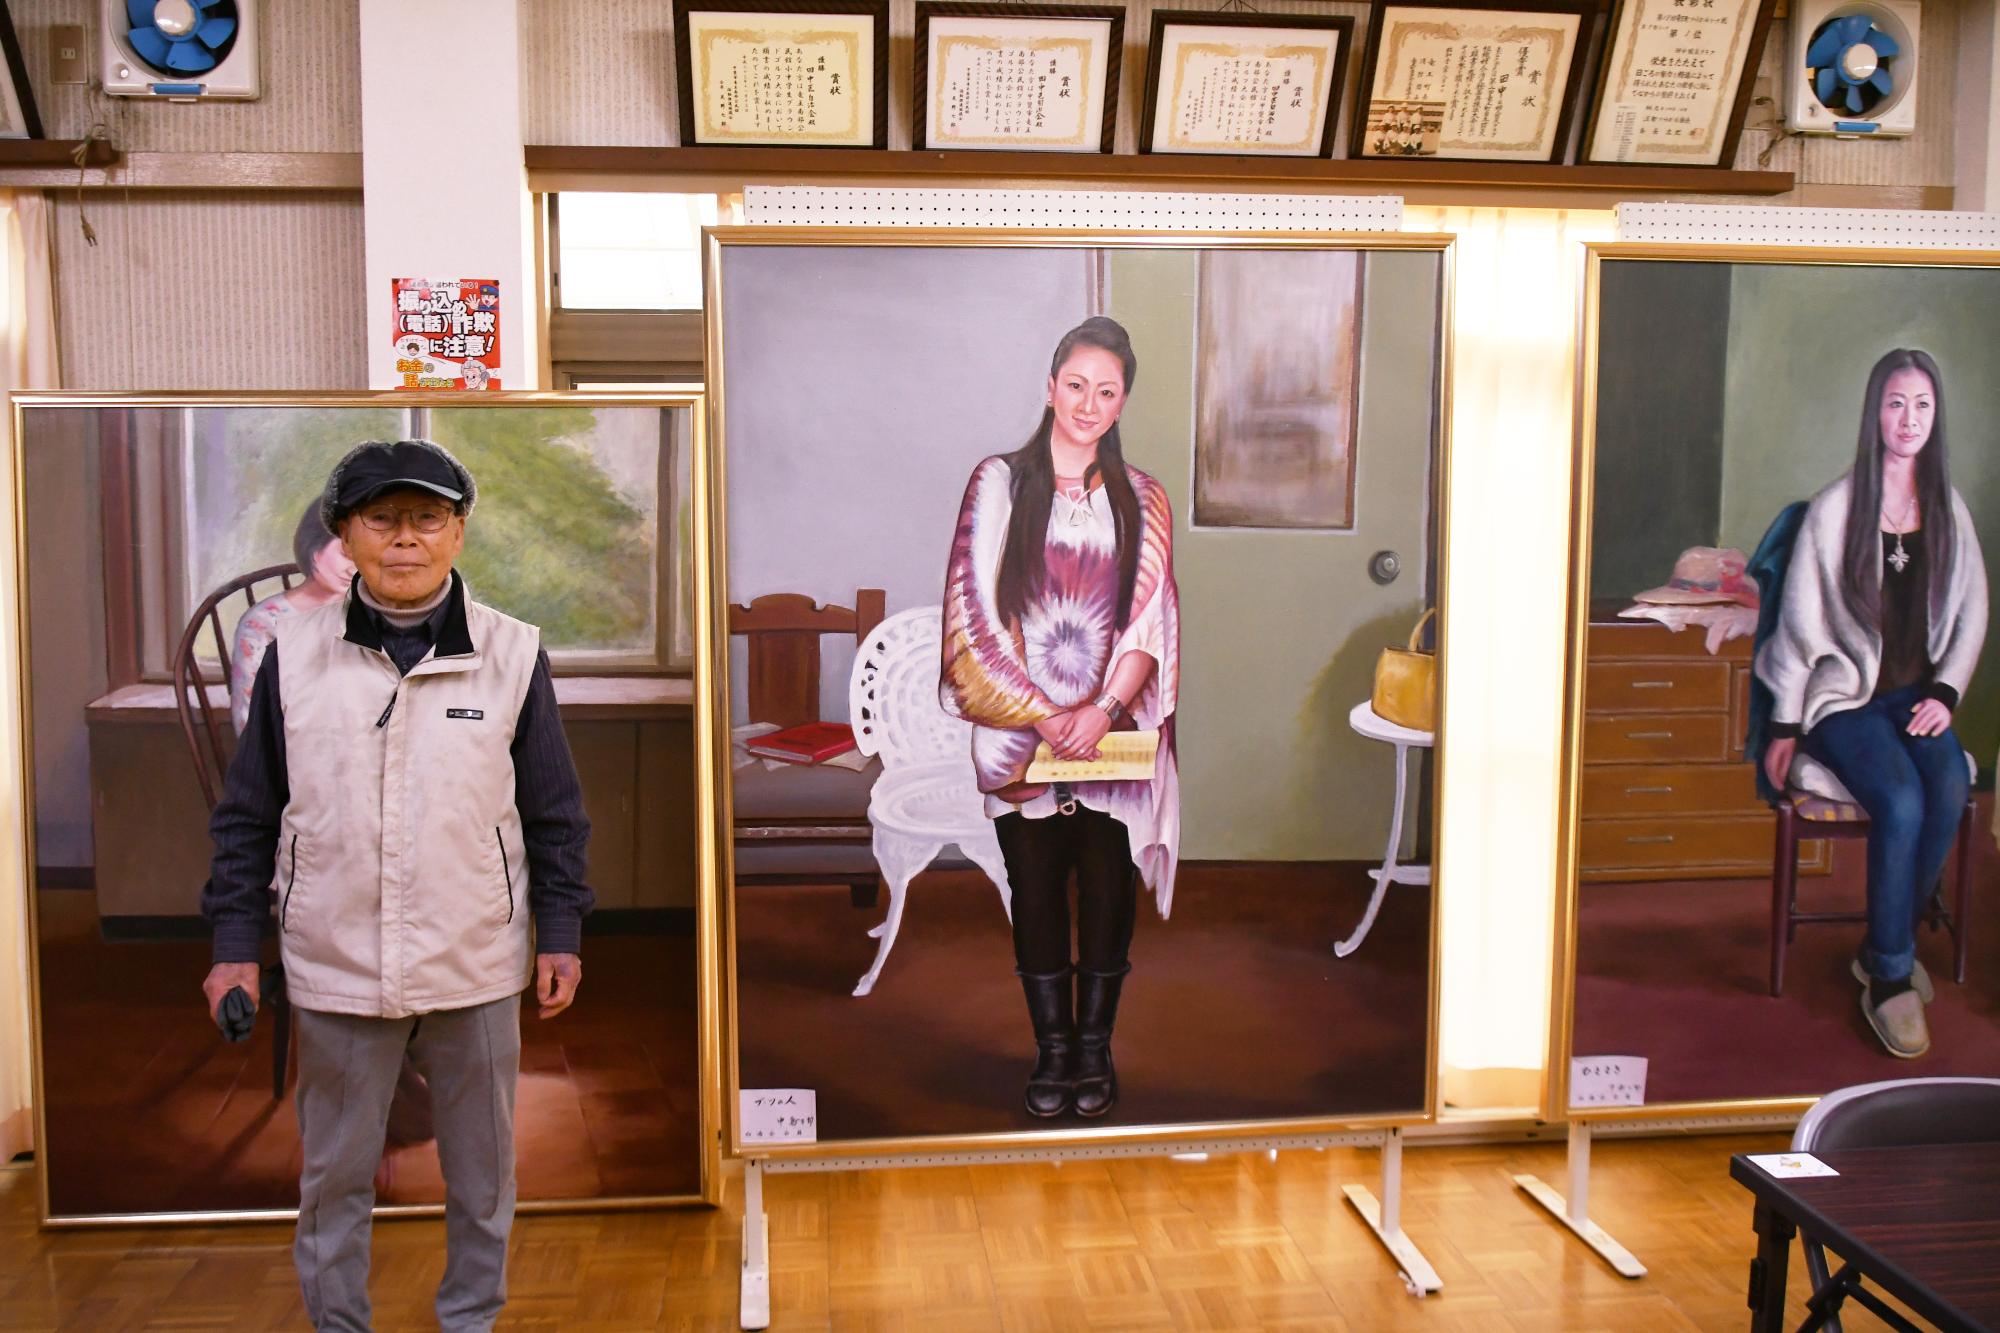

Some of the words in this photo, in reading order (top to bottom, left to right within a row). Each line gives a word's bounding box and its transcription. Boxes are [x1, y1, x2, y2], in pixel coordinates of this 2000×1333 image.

[830, 73, 842, 96] 賞状
[1059, 76, 1071, 98] 賞状
[1290, 86, 1304, 108] 賞状
[398, 289, 467, 315] 振り込め
[429, 334, 496, 357] に注意!
[397, 358, 435, 373] お金の
